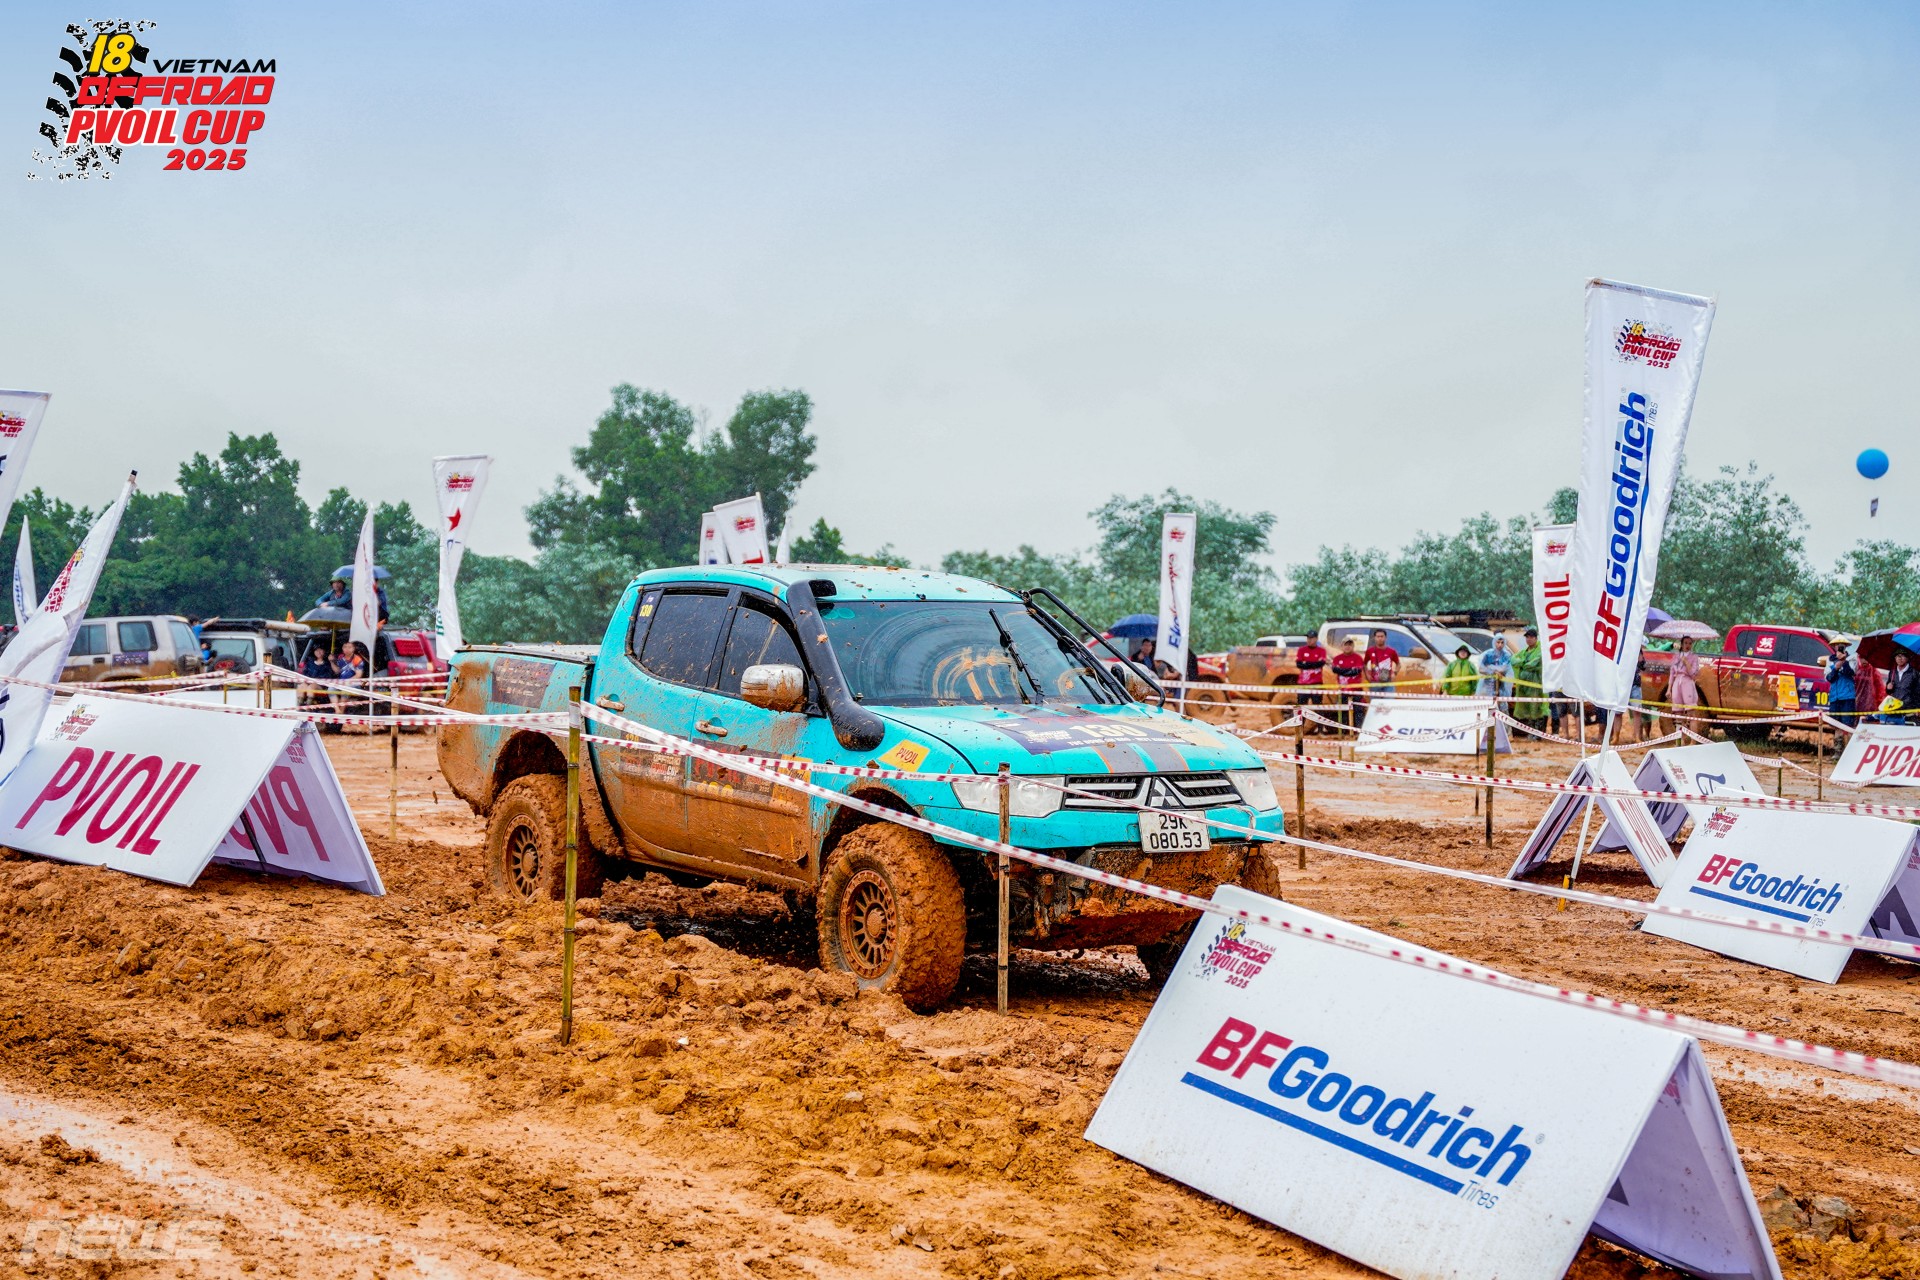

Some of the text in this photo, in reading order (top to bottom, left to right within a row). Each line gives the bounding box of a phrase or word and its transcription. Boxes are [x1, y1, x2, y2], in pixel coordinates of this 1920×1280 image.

[1647, 333, 1682, 343] VIETNAM
[1622, 343, 1677, 362] PVOIL CUP
[1646, 359, 1670, 369] 2025
[1593, 391, 1647, 661] BFGoodrich
[1543, 573, 1571, 661] PVOIL
[1068, 724, 1148, 738] 130
[15, 747, 202, 856] PVOIL
[1149, 831, 1203, 849] 080.53
[1696, 853, 1844, 914] BFGoodrich
[1227, 923, 1246, 940] 18
[1216, 936, 1273, 966] OFFROAD
[1243, 937, 1278, 954] VIETNAM
[1205, 950, 1263, 980] PVOIL CUP
[1224, 974, 1250, 990] 2025
[1196, 1016, 1533, 1187] BFGoodrich
[1460, 1178, 1500, 1210] Tires
